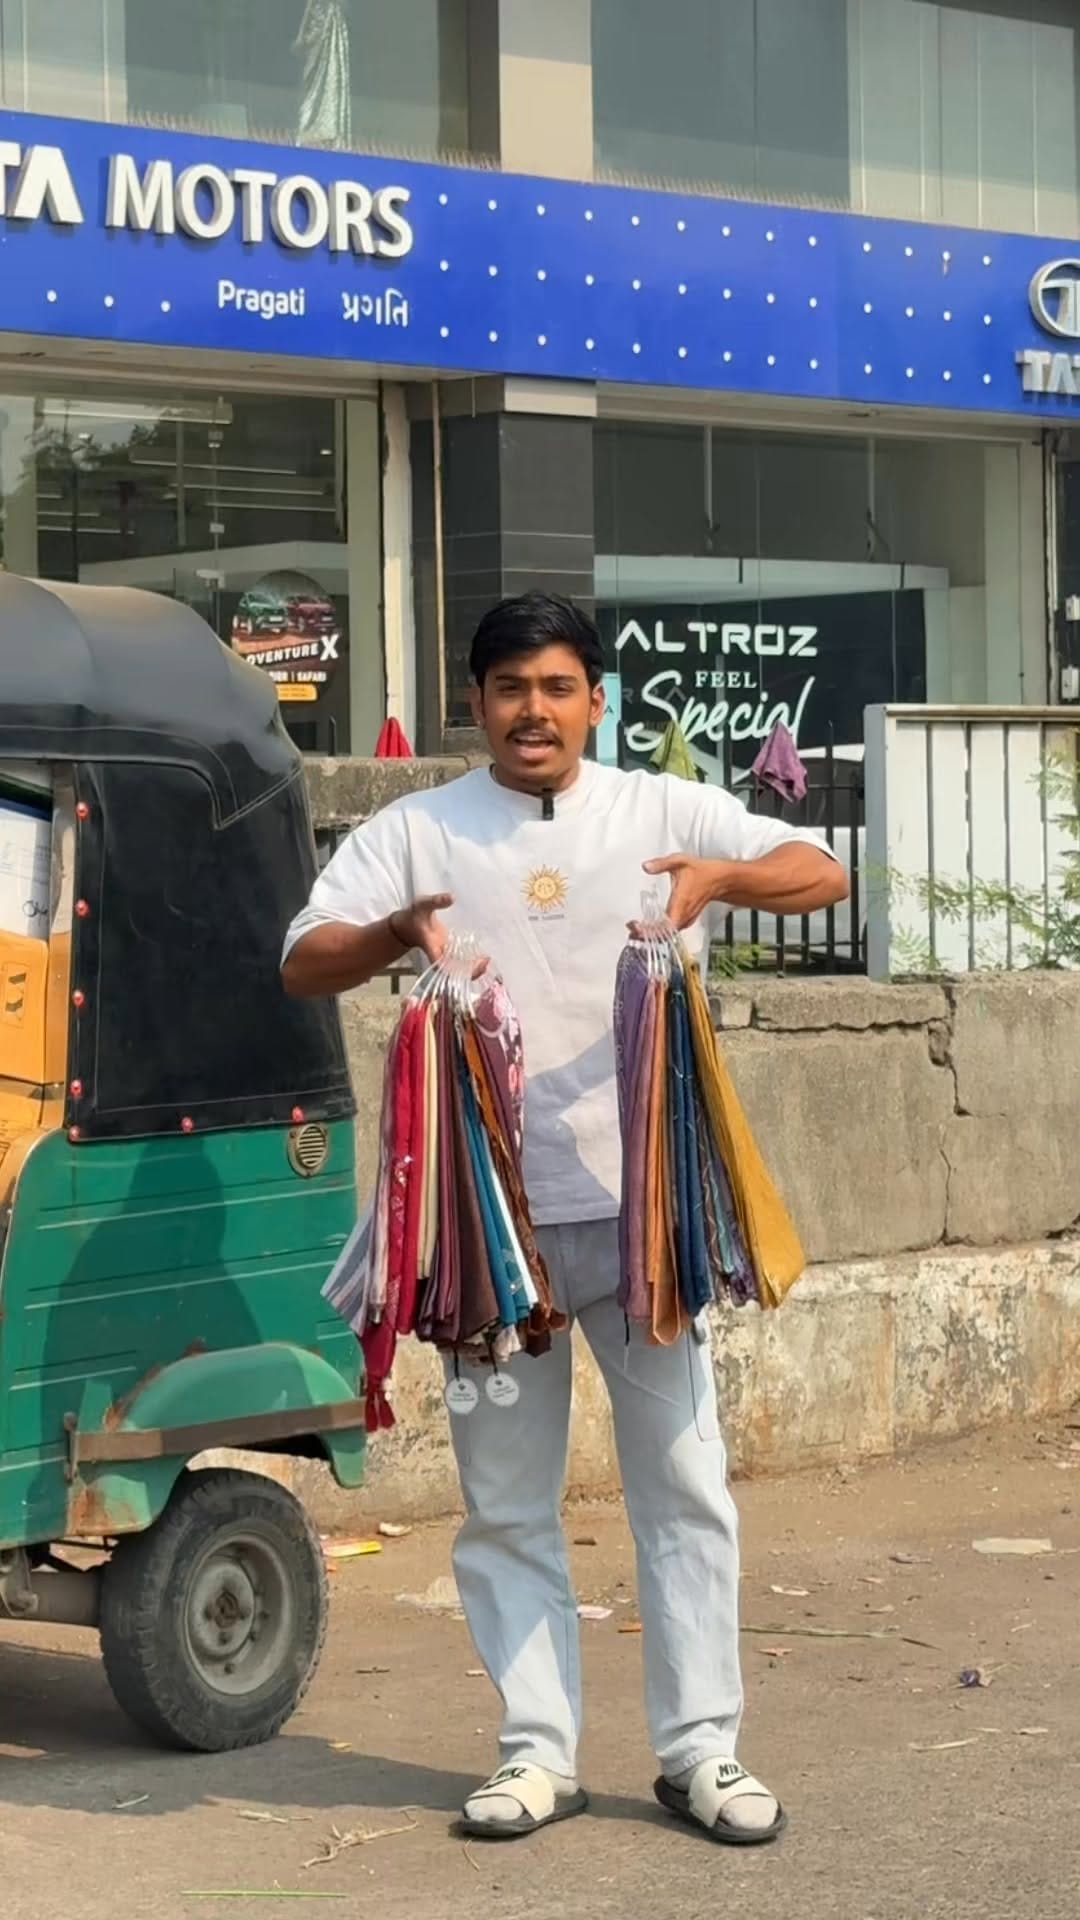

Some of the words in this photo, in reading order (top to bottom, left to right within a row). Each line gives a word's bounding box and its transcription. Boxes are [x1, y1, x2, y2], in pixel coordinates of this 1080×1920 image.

[105, 153, 414, 258] MOTORS
[218, 279, 305, 320] Pragati
[342, 287, 409, 327] પ્રગતિ
[1015, 349, 1080, 396] TA
[246, 642, 319, 666] DVENTURE
[320, 633, 339, 661] X
[615, 619, 818, 657] ALTROZ
[695, 670, 757, 688] FEEL
[625, 669, 816, 752] Special
